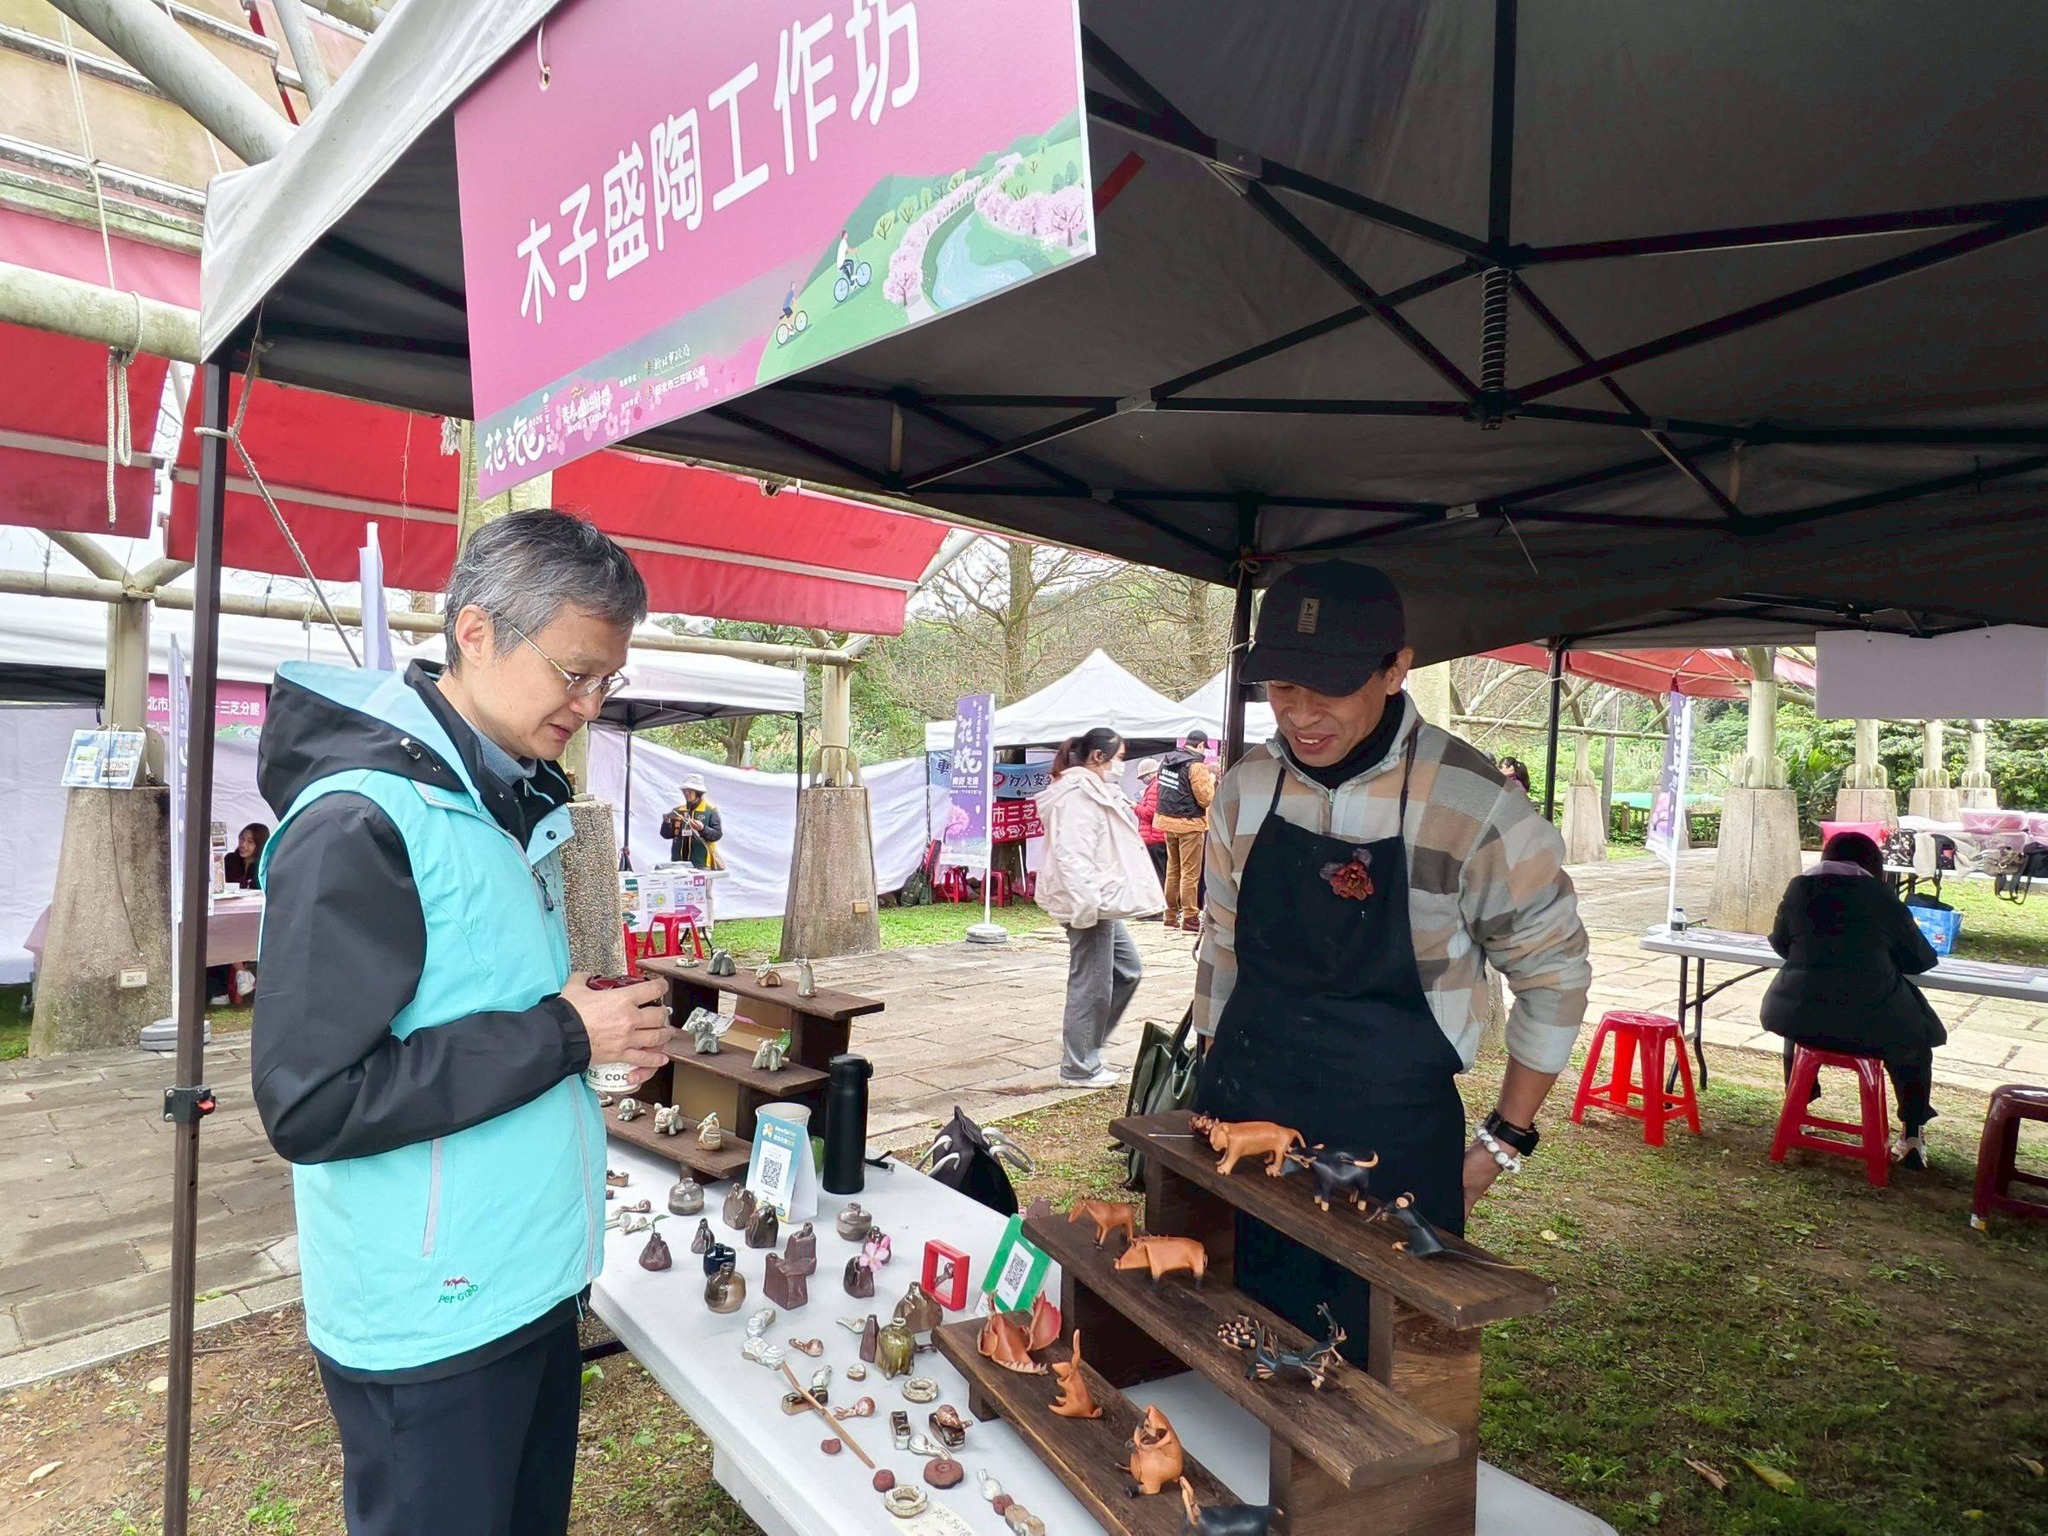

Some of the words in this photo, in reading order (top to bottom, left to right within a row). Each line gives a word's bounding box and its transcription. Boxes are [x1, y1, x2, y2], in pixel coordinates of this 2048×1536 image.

[516, 0, 920, 324] 木子盛陶工作坊
